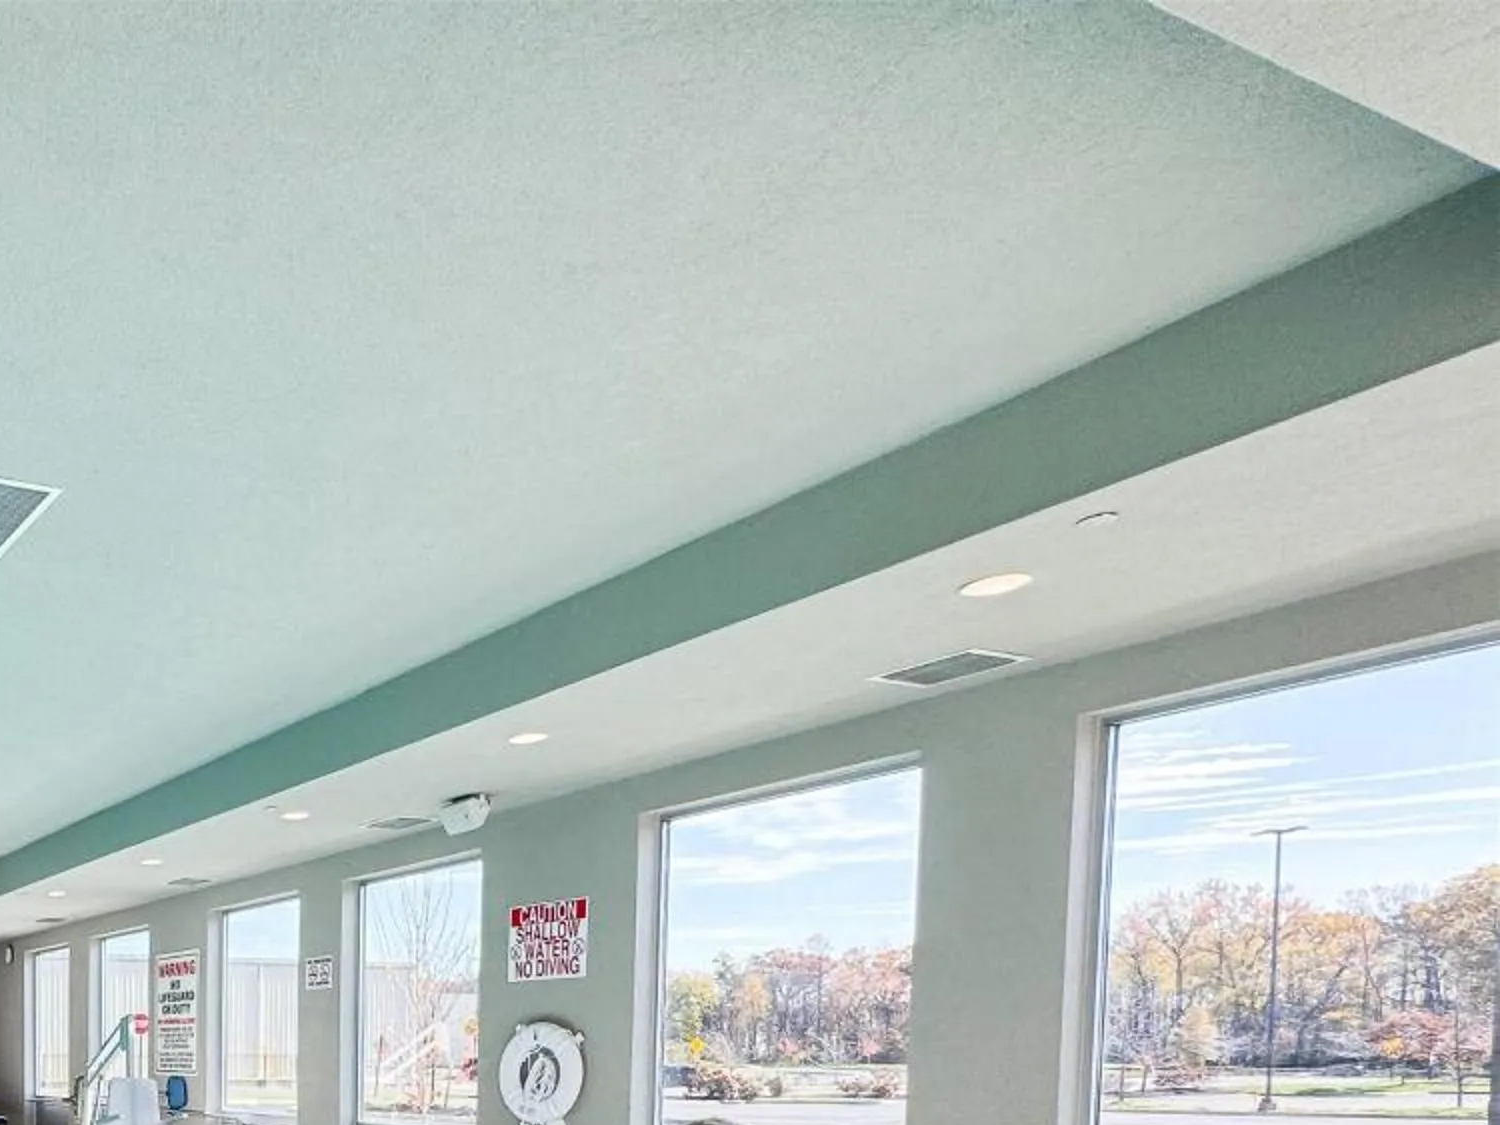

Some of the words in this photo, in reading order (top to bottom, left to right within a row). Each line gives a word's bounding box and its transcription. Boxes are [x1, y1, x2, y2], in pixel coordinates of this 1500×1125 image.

[519, 900, 577, 925] CAUTION
[516, 920, 580, 944] SHALLOW
[524, 939, 570, 959] WATER
[515, 960, 532, 978] NO
[536, 956, 580, 976] DIVING
